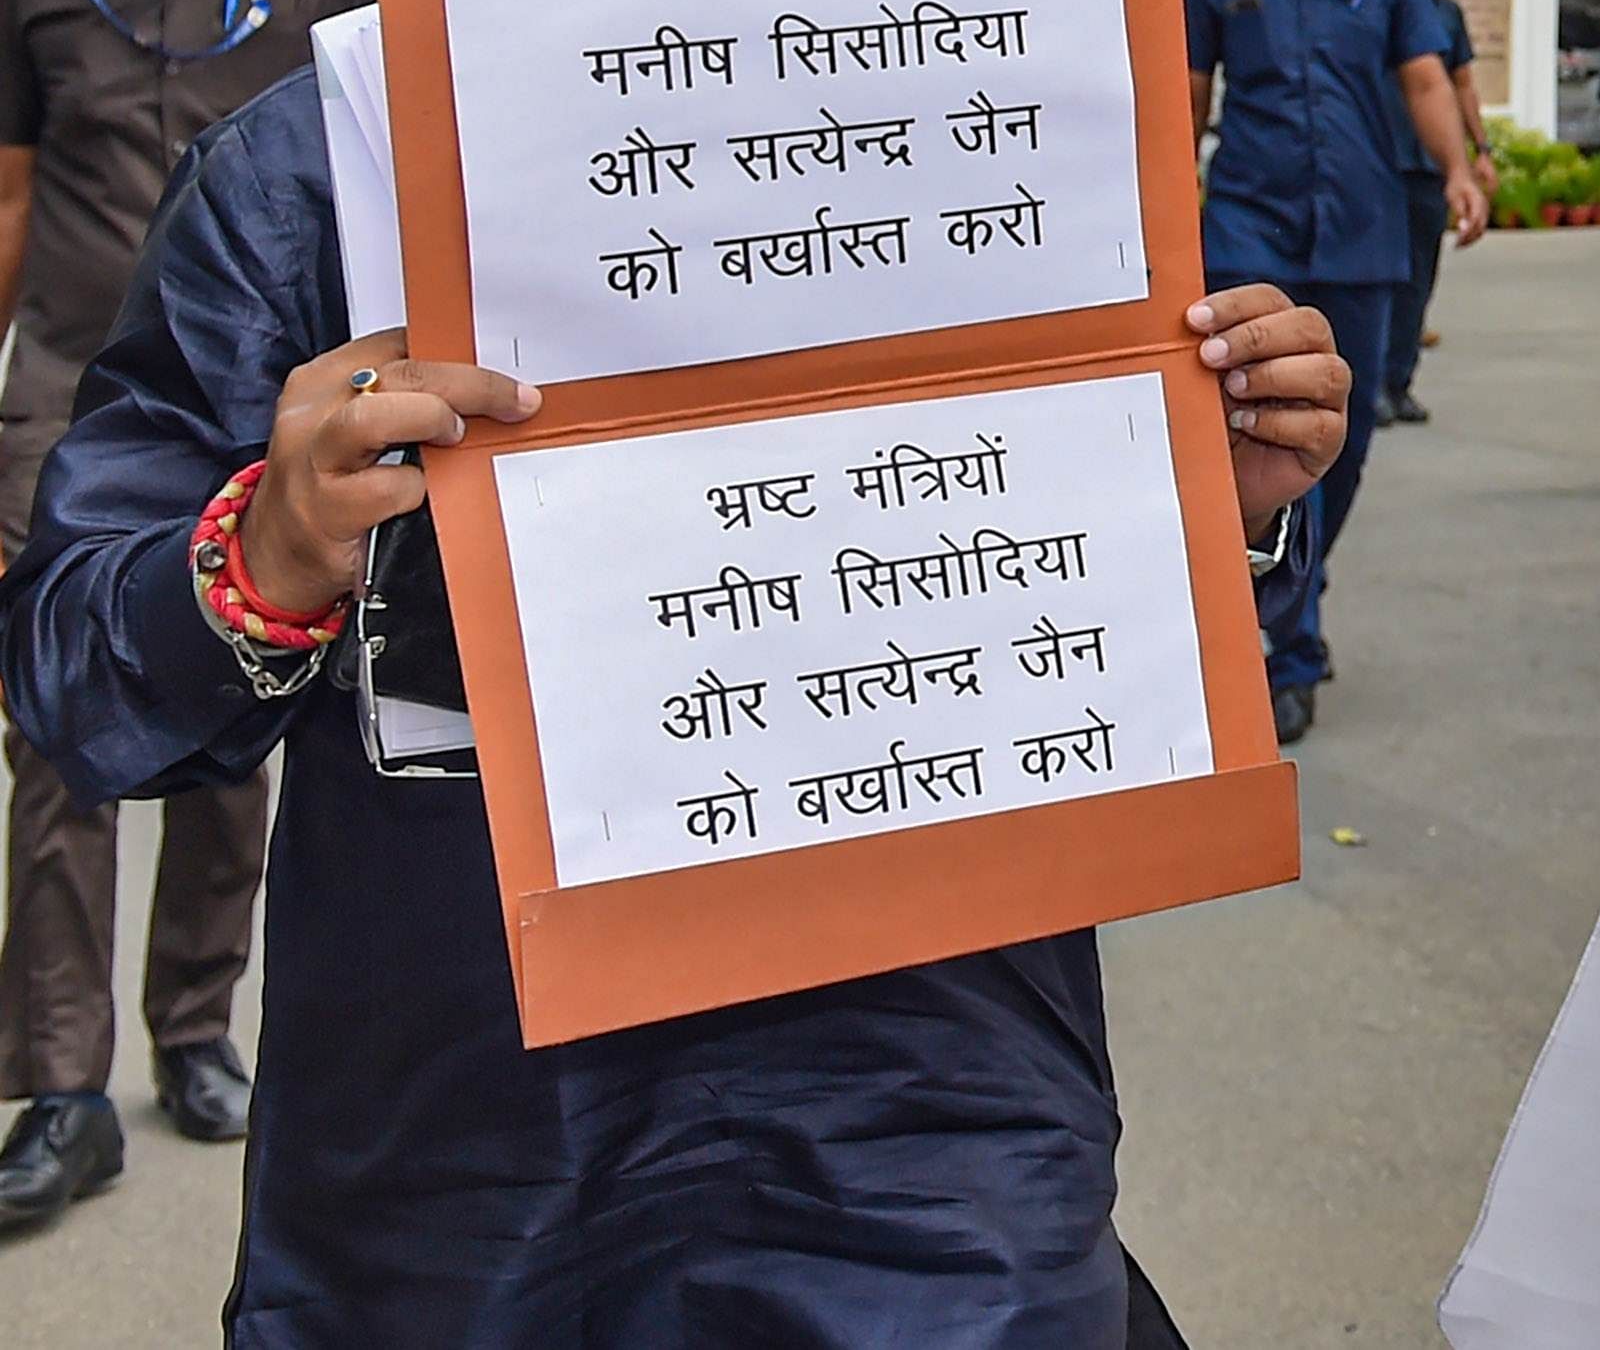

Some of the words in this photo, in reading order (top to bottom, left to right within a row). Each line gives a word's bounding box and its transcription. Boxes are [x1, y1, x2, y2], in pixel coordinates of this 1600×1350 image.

[582, 25, 739, 96] मनीष
[767, 1, 1029, 80] सिसोदिया
[588, 126, 697, 197] और
[726, 107, 916, 182] सत्येन्द्र
[945, 90, 1042, 155] जैन
[599, 227, 683, 300] को
[713, 206, 911, 285] बर्खास्त
[939, 183, 1046, 255] करो
[706, 473, 817, 530] भ्रष्ट
[845, 433, 1007, 510] मंत्रियों
[648, 565, 802, 638] मनीष
[830, 528, 1087, 614] सिसोदिया
[662, 668, 767, 740] और
[796, 640, 982, 719] सत्येन्द्र
[1011, 615, 1106, 680] जैन
[676, 770, 759, 845] को
[788, 740, 984, 825] बर्खास्त
[1012, 707, 1116, 783] करो
